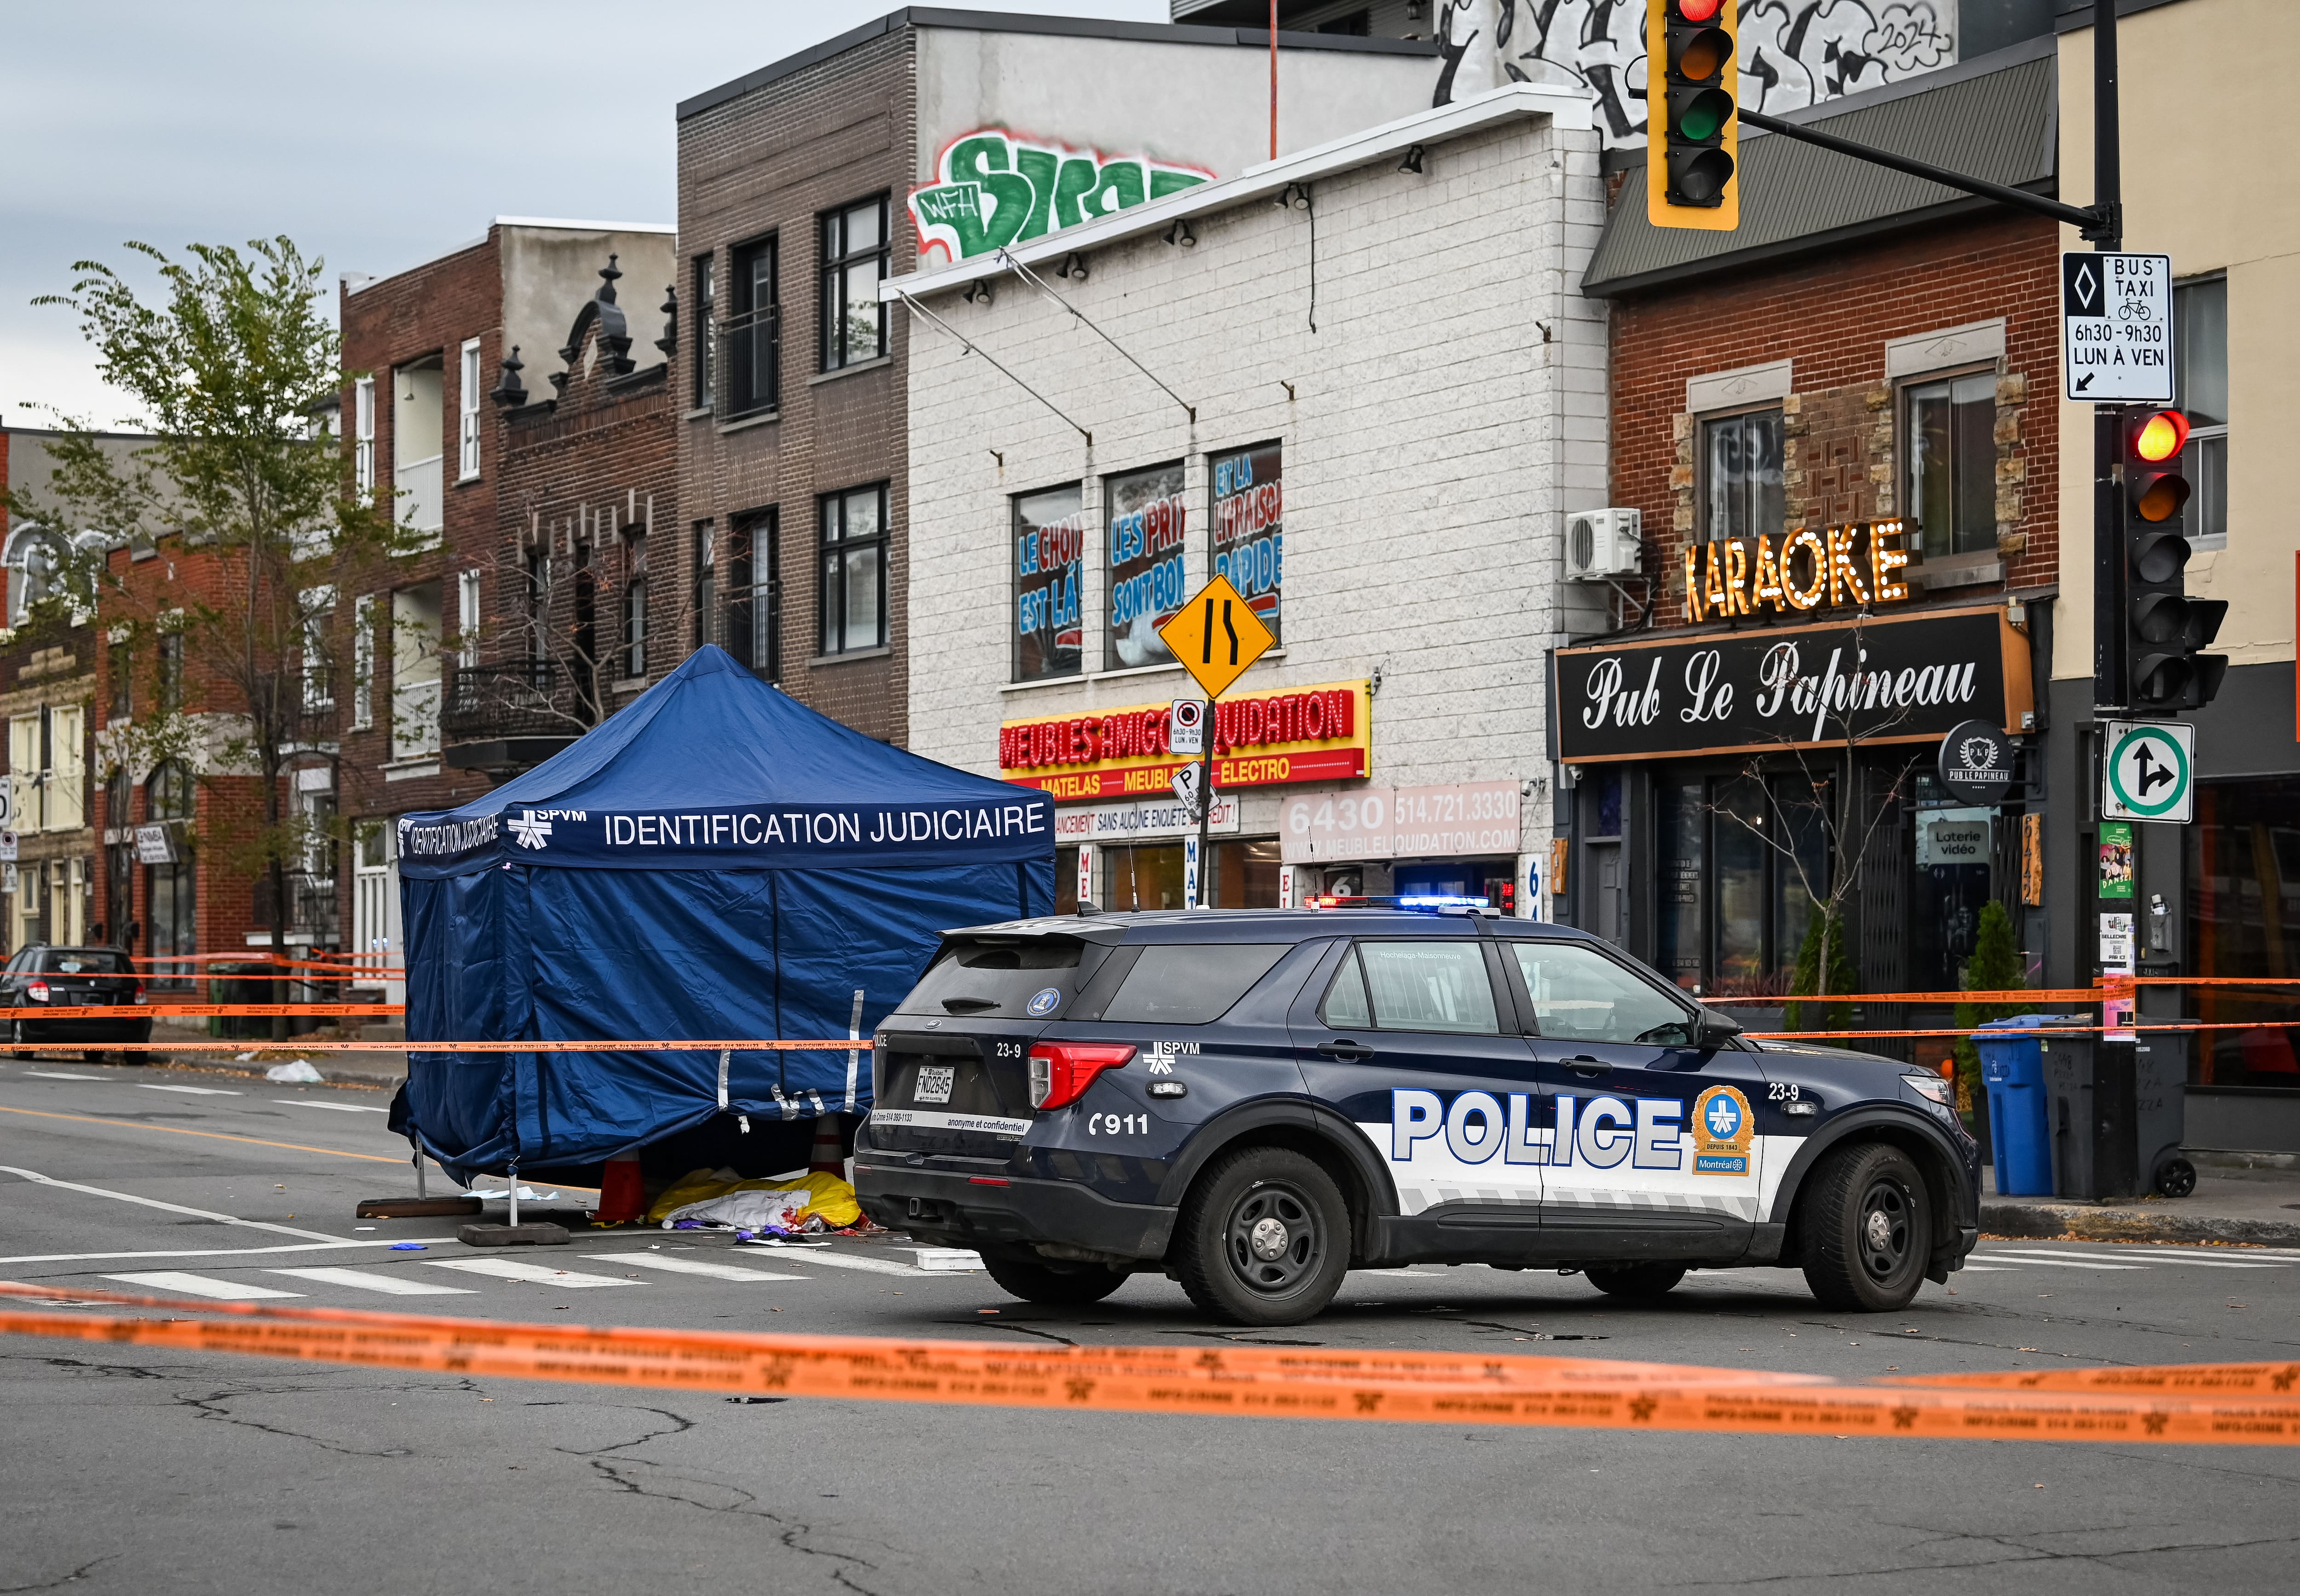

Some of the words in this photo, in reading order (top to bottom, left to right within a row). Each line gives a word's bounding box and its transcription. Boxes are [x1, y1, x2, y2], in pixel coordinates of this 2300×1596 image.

[1878, 19, 1941, 55] 2024
[921, 186, 978, 221] WFH
[2115, 259, 2153, 276] BUS
[2115, 280, 2153, 297] TAXI
[2074, 347, 2107, 365] LUN
[2113, 345, 2125, 365] À
[2131, 349, 2164, 366] VEN
[1215, 460, 1233, 497] ET
[1234, 453, 1252, 490] LA
[1111, 510, 1144, 566] LES
[1019, 531, 1037, 576] LE
[1685, 517, 1911, 623] KARAOKE
[1112, 569, 1151, 627] SONT
[1152, 553, 1184, 613] BON
[1019, 586, 1047, 635] EST
[1583, 657, 1662, 729] Pub
[1680, 650, 1734, 723] Le
[1756, 641, 1976, 742] Papineau
[1000, 717, 1101, 769] MEUBLES
[1041, 774, 1101, 798] MATELAS
[1124, 767, 1181, 792] MEUBL
[1221, 757, 1290, 784] ÉLECTRO
[1179, 769, 1192, 790] P
[1949, 770, 1963, 780] PUB
[1965, 771, 1973, 780] LE
[1974, 771, 2009, 781] PAPINEAU
[537, 809, 587, 822] SPVM
[1055, 813, 1095, 834] ANCEMENT
[1098, 812, 1117, 831] SANS
[1119, 809, 1150, 829] AUCUNE
[1151, 805, 1187, 828] ENQUÊTE
[1289, 796, 1384, 834] 6430
[1395, 790, 1516, 824] 514.721.3330
[411, 823, 461, 855] IDENTIFICATION
[461, 812, 500, 851] JUDICIAIRE
[605, 812, 860, 846] IDENTIFICATION
[870, 802, 1045, 843] JUDICIAIRE
[1283, 829, 1516, 859] WWW.MEUBLELIQUIDATION.COM
[1936, 832, 1981, 843] Loterie
[1941, 844, 1976, 855] vidéo
[1380, 951, 1461, 960] Hochelaga-Maisonneuve
[875, 1034, 887, 1047] OLICE
[996, 1042, 1021, 1058] 23-9
[1163, 1041, 1200, 1055] SPVM
[916, 1075, 951, 1094] FND2645
[1768, 1082, 1799, 1102] 23-9
[893, 1113, 912, 1122] 393-1133
[948, 1118, 975, 1130] anonyme
[983, 1120, 1025, 1133] confidentiel
[1104, 1113, 1148, 1135] 911
[1391, 1086, 1684, 1171] POLICE
[1699, 1159, 1732, 1169] Montréal
